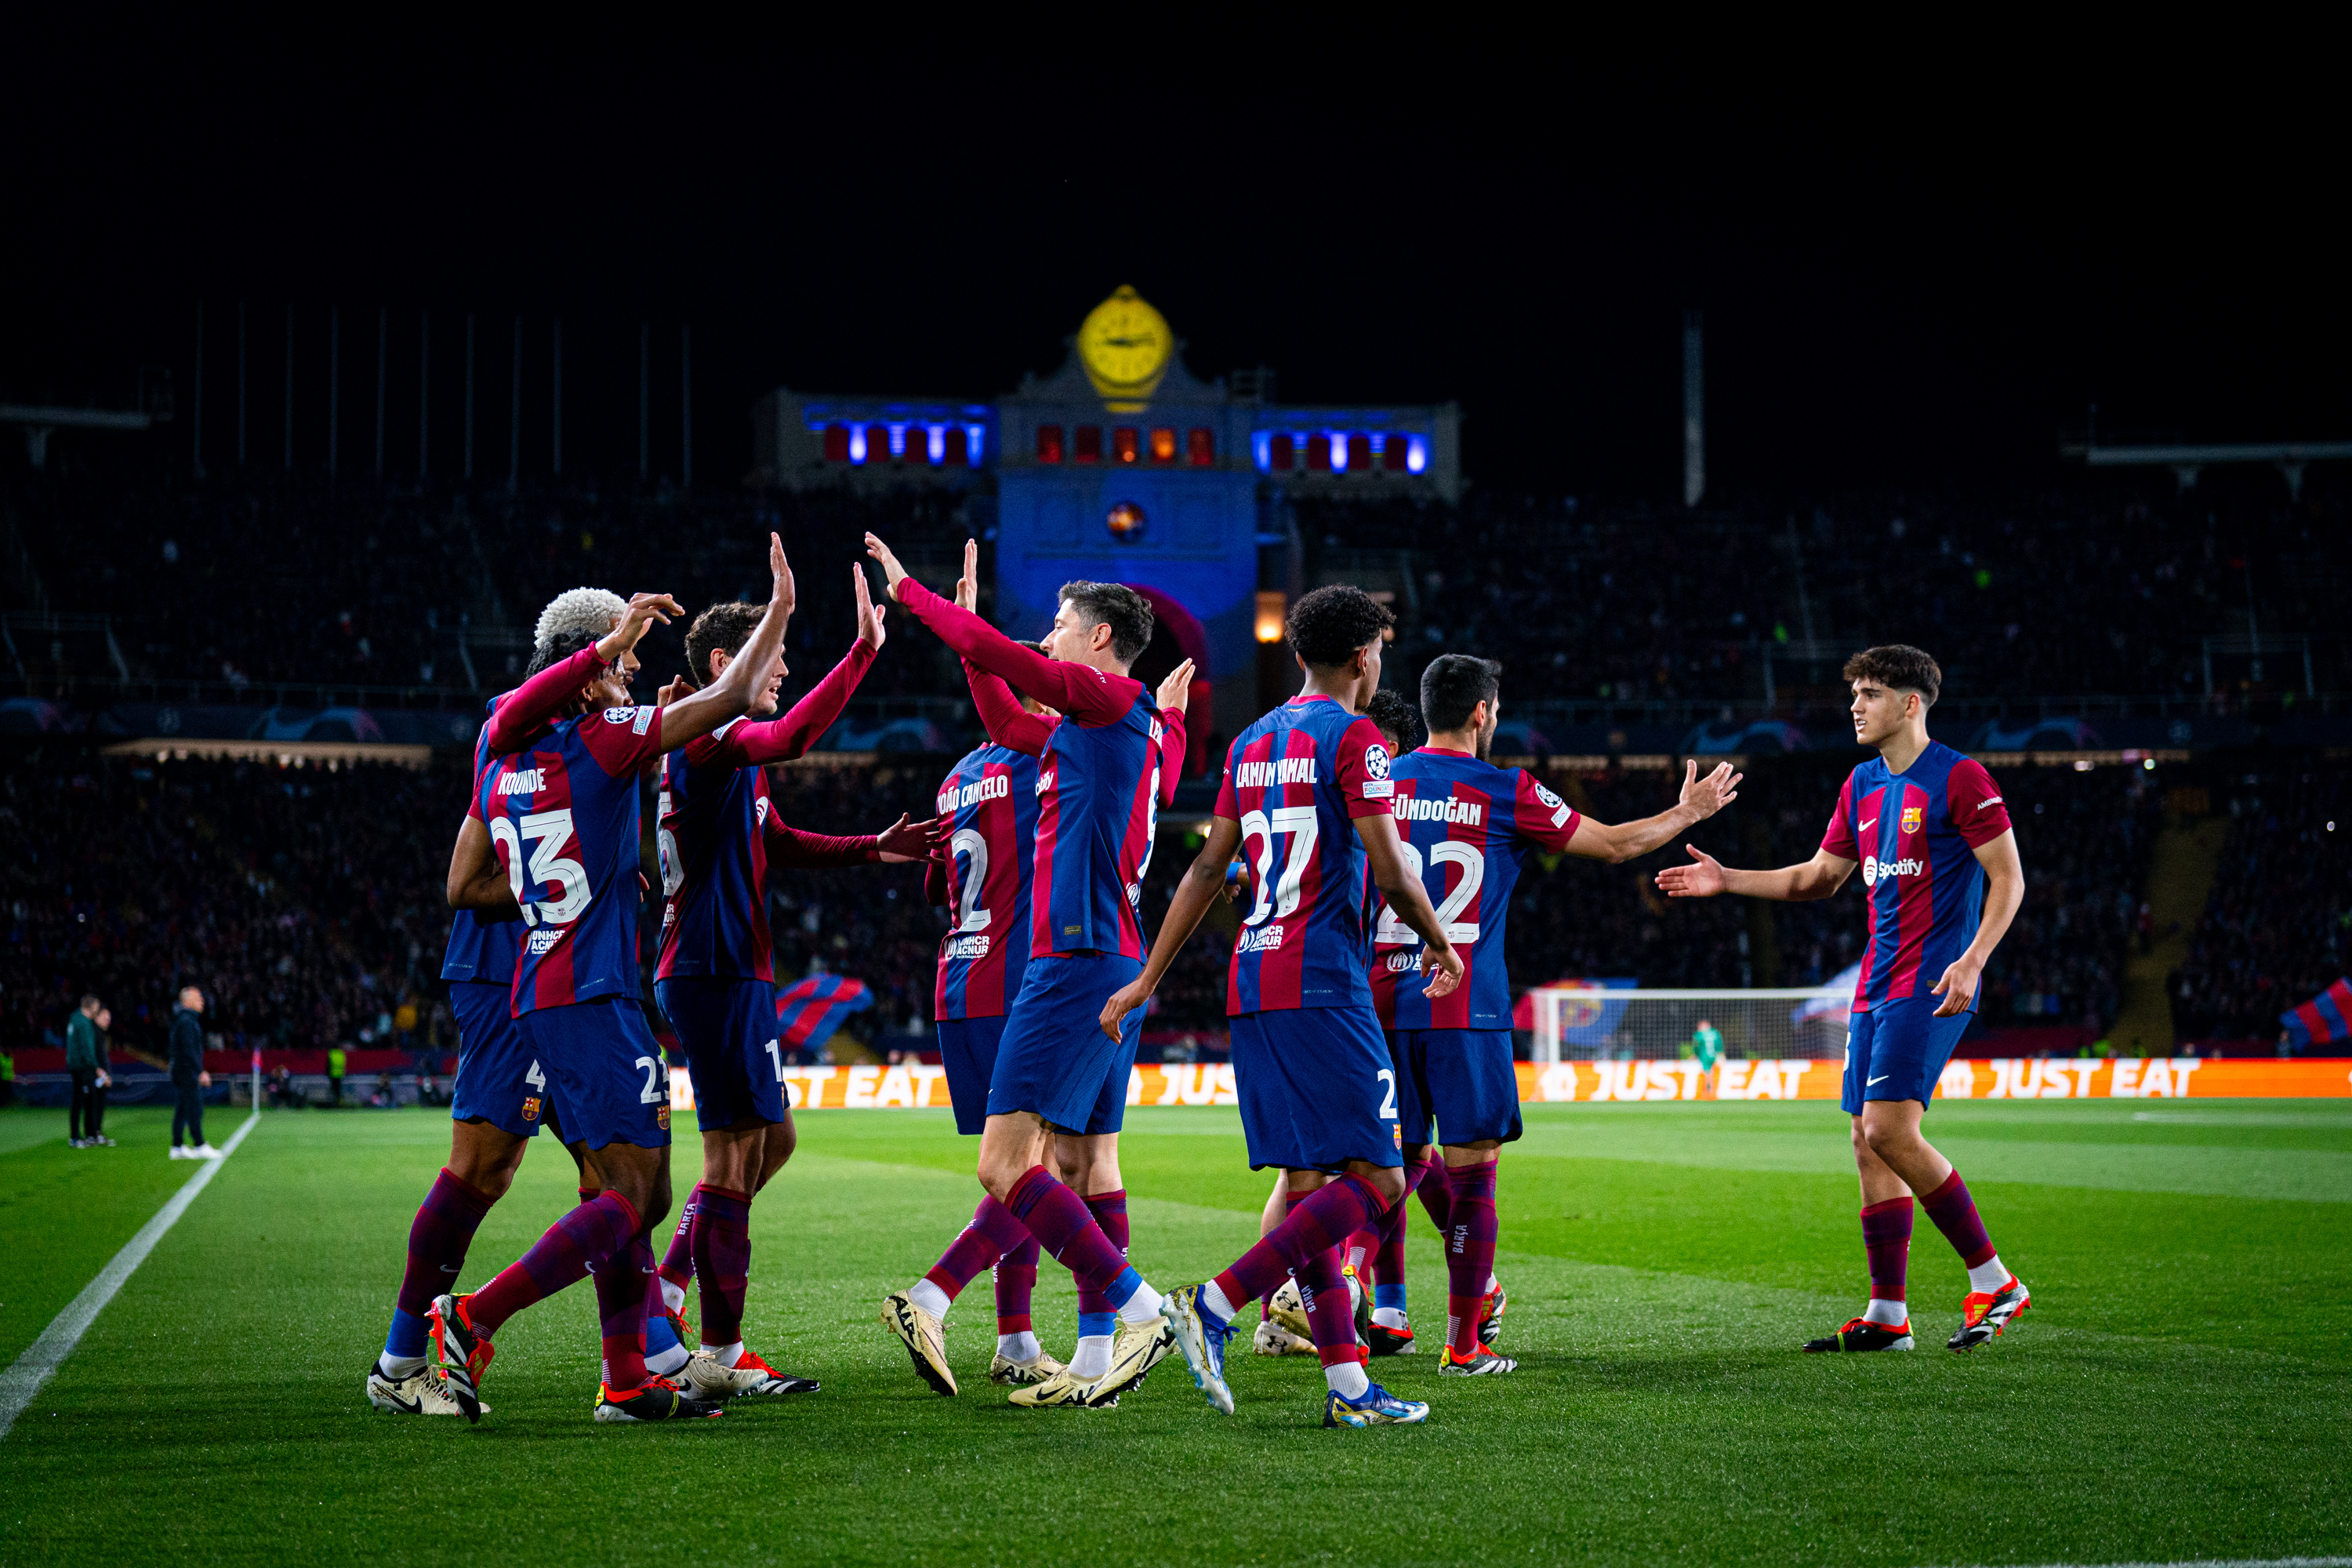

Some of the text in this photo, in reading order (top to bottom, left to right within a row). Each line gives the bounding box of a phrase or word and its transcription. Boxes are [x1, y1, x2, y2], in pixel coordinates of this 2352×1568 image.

[637, 706, 649, 734] FOUNDAT
[497, 768, 546, 796] KOUNDE
[1035, 771, 1054, 797] otify
[1236, 757, 1318, 789] LAMIN YAMAL
[960, 775, 1008, 808] CANCELO
[490, 808, 593, 927] 23
[950, 828, 992, 932] 2
[1240, 805, 1319, 926] 27
[1878, 858, 1924, 880] Spotify
[1374, 840, 1485, 945] 22
[531, 940, 558, 951] ACN
[956, 945, 989, 955] ACNUR
[1250, 935, 1283, 949] ACNUR
[525, 1058, 546, 1093] 4
[764, 1039, 782, 1083] 1
[782, 1064, 945, 1109] ST EAT
[1156, 1063, 1239, 1106] JUS
[1377, 1069, 1397, 1119] 2
[1589, 1059, 1813, 1101] JUST EAT
[1986, 1058, 2201, 1098] JUST EAT
[677, 1203, 697, 1236] BARÇA
[1452, 1225, 1468, 1254] BARÇA
[1301, 1284, 1316, 1314] BARÇA
